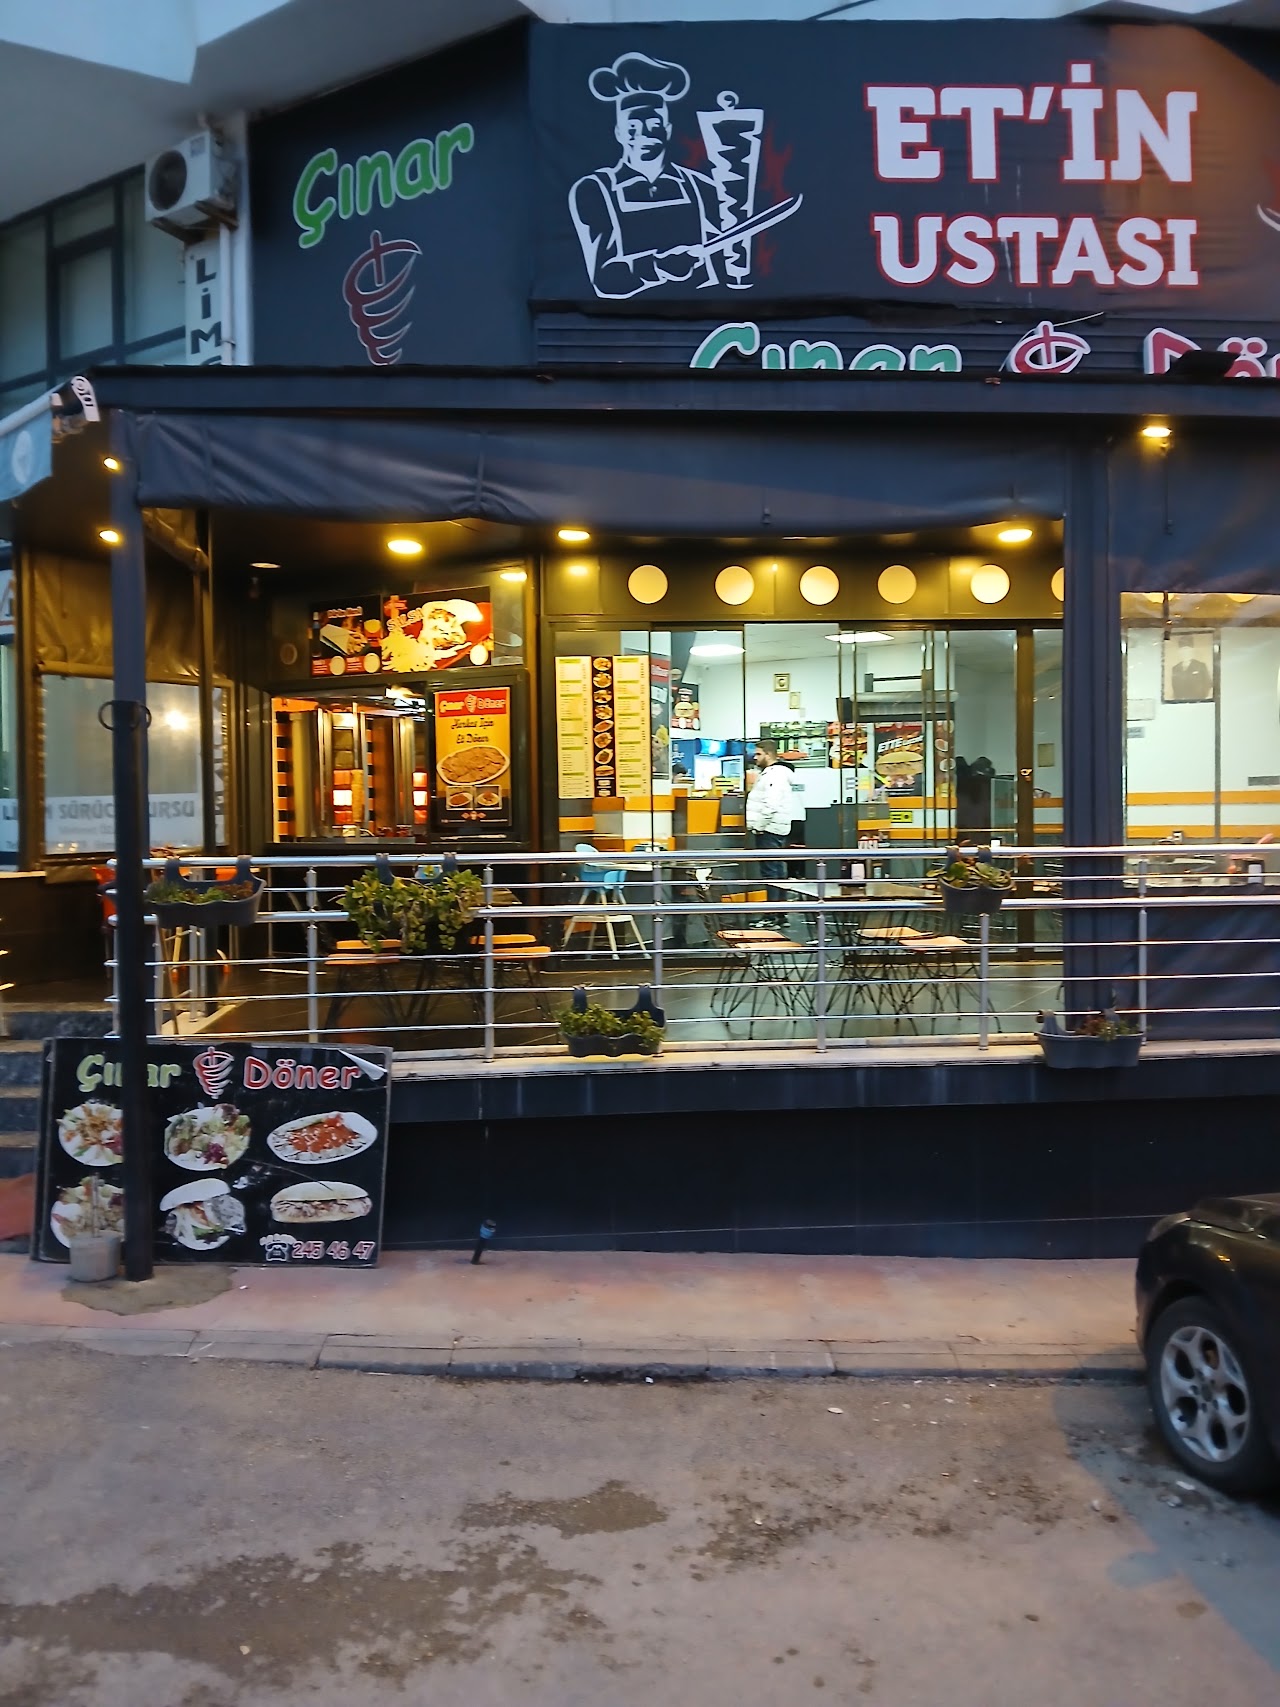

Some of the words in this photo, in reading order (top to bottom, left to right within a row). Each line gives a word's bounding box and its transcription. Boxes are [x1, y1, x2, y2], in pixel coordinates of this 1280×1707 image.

[866, 62, 1198, 184] ET'İN
[292, 122, 474, 249] Çınar
[873, 215, 1199, 287] USTASI
[243, 1054, 362, 1091] Döner
[291, 1240, 325, 1260] 245
[325, 1240, 351, 1261] 46
[351, 1240, 376, 1261] 47
